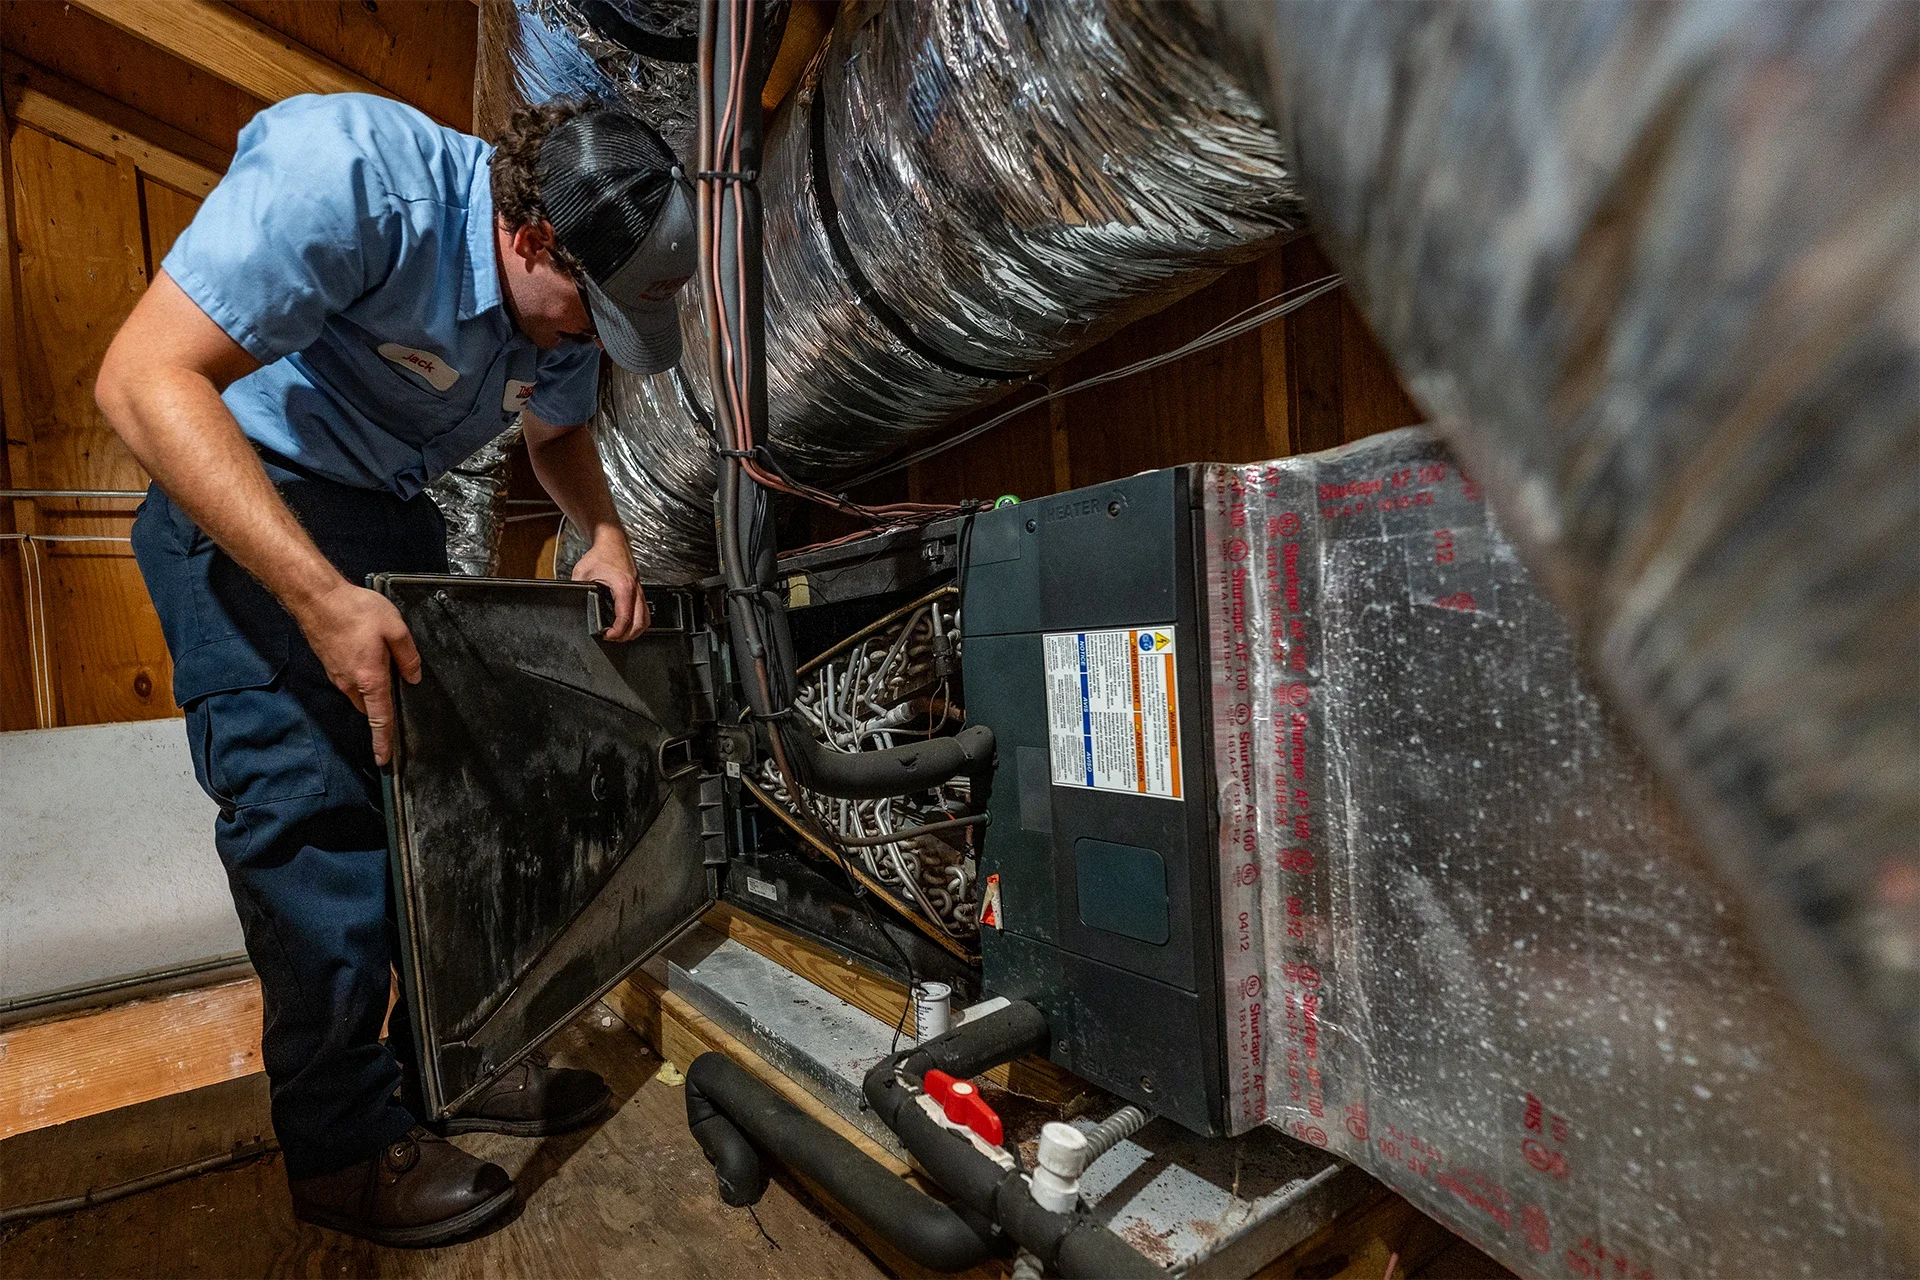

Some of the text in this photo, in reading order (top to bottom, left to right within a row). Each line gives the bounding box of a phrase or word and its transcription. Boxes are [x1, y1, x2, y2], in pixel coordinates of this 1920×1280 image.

[402, 353, 435, 374] Jack
[1230, 502, 1247, 528] 100
[1266, 546, 1280, 593] 181A-P
[1284, 543, 1300, 612] Shurtape
[1220, 570, 1231, 615] 181A-P
[1231, 568, 1248, 633] Shurtape
[1290, 620, 1306, 640] AF
[1222, 629, 1233, 682] 181B-FX
[1235, 641, 1249, 662] AF
[1291, 645, 1307, 671] 100
[1131, 644, 1139, 703] AVERTISSEMENT
[1236, 666, 1249, 691] 100
[1169, 711, 1177, 746] WARNING
[1273, 713, 1287, 759] 181A-P
[1289, 713, 1308, 780] Shurtape
[1135, 731, 1144, 782] ADVERTENCIA
[1228, 734, 1239, 778] 181A-P
[1239, 731, 1253, 796] Shurtape
[1244, 804, 1255, 824] AF
[1275, 773, 1289, 827] 181B-FX
[1293, 788, 1310, 809] AF
[1243, 827, 1257, 852] 100
[1294, 814, 1311, 840] 100
[1238, 911, 1251, 953] 04/12
[1239, 1007, 1249, 1052] 181A-P
[1248, 1003, 1262, 1066] Shurtape
[1241, 1065, 1252, 1117] 181B-FX
[1252, 1074, 1264, 1092] AF
[1306, 1066, 1321, 1088] AF
[1254, 1098, 1266, 1123] 100
[1307, 1094, 1324, 1118] 100
